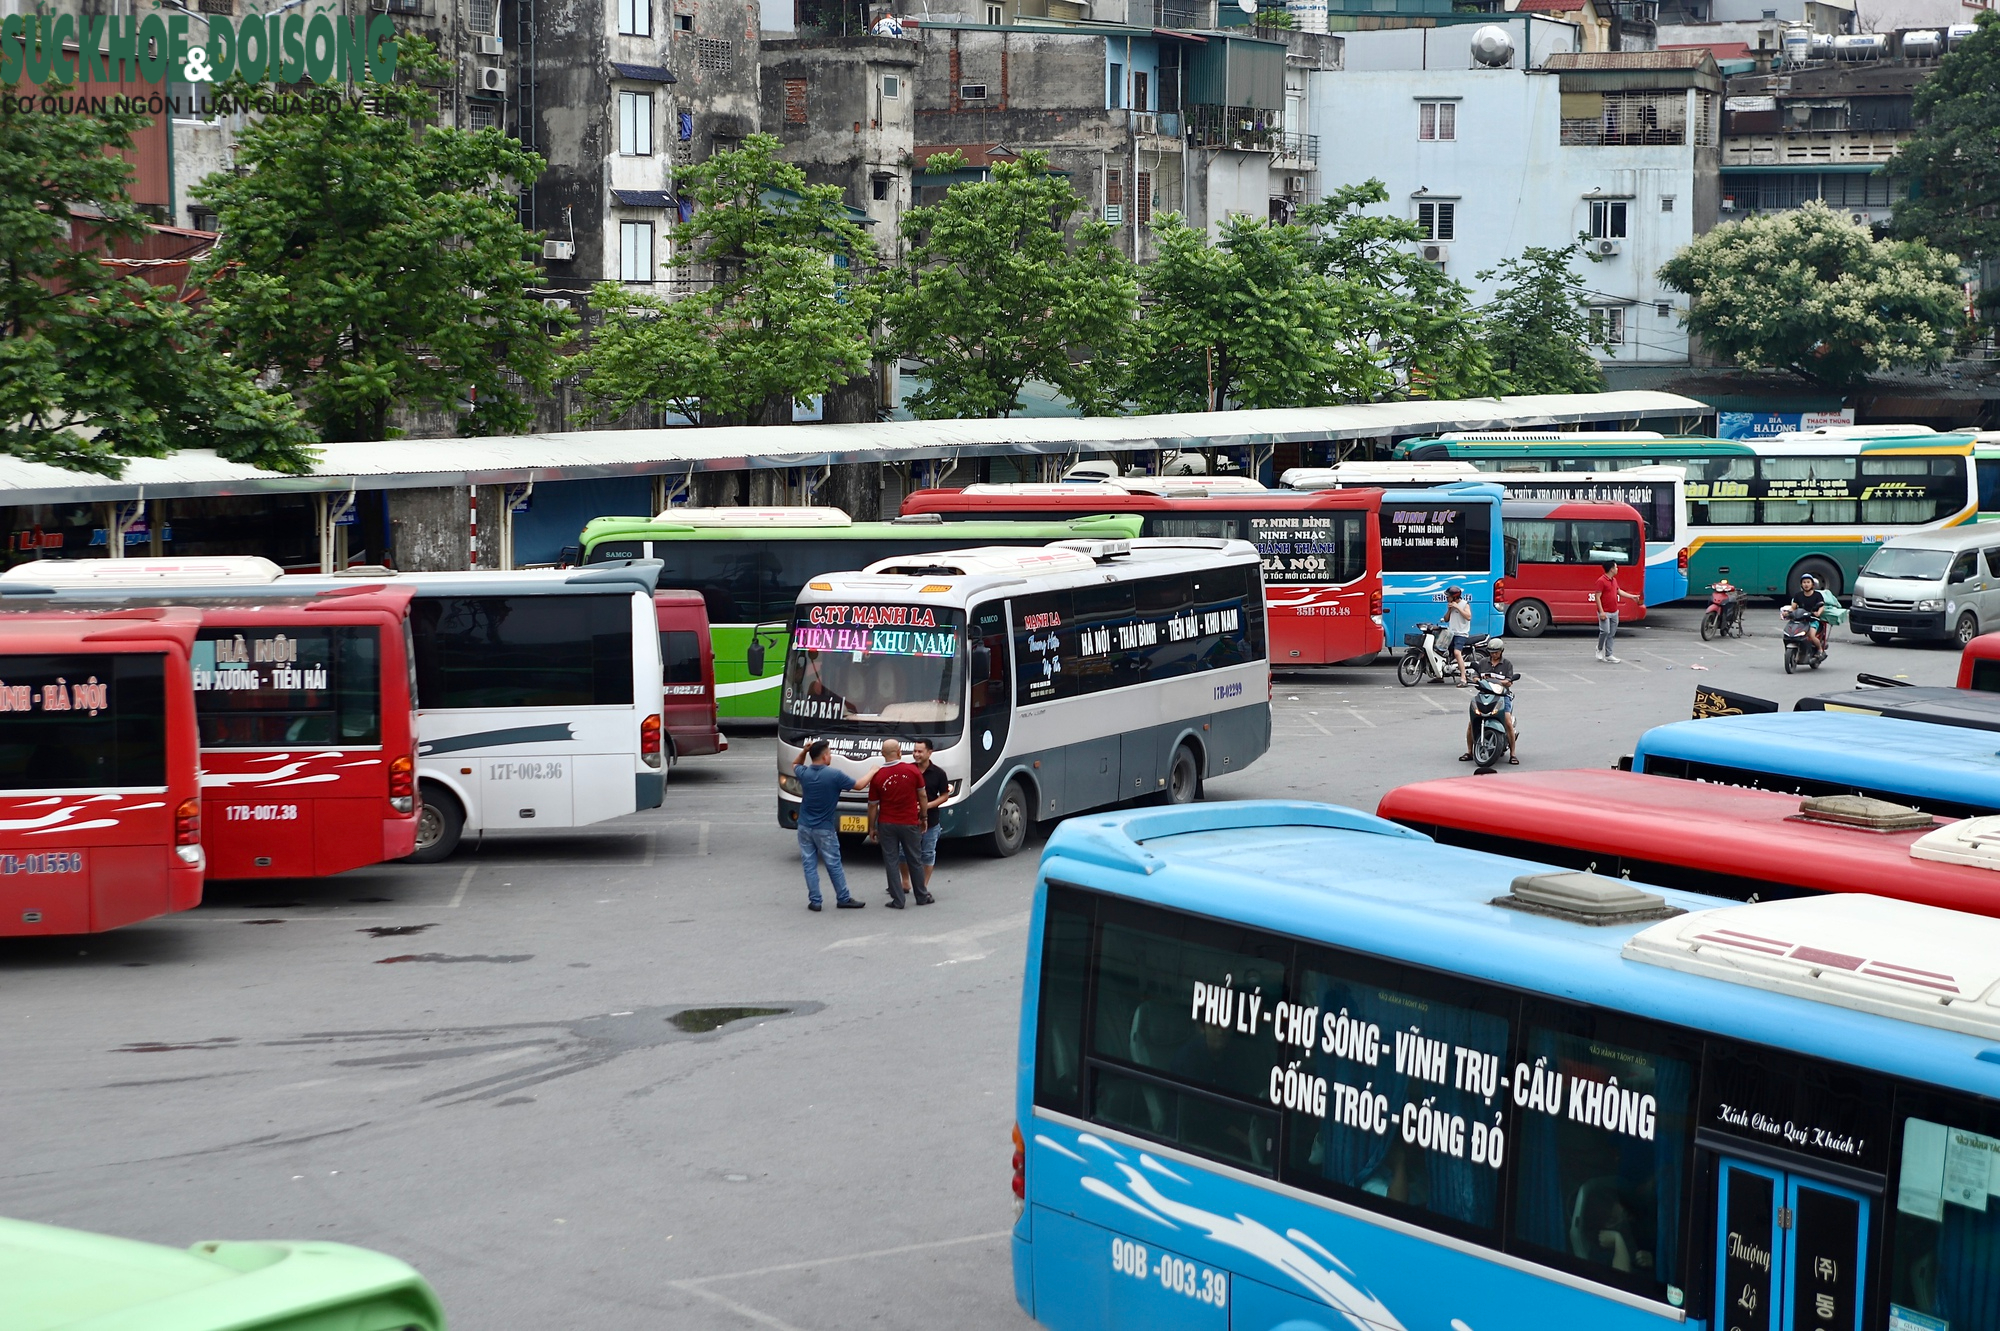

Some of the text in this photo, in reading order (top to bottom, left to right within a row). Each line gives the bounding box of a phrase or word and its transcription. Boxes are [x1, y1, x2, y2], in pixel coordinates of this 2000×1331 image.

[1302, 515, 1331, 528] BÌNH
[1398, 523, 1444, 534] TP NINH BÌNH
[1259, 531, 1288, 540] NINH
[1289, 555, 1326, 572] NỘI
[810, 606, 936, 629] C.TY MẠNH LA
[980, 615, 998, 624] SAMCO
[1024, 611, 1062, 632] MẠNH LA
[913, 632, 955, 655] NAM
[1081, 627, 1094, 656] HÀ
[1094, 624, 1111, 657] NỘI
[1118, 621, 1138, 650] THÁI
[1138, 620, 1157, 647] BÌNH
[1185, 608, 1199, 640] HẢI
[1204, 613, 1221, 635] KHU
[1220, 609, 1239, 632] NAM
[216, 633, 298, 669] HÀ NỘI
[214, 668, 259, 691] XƯƠNG
[304, 662, 327, 690] HẢI
[43, 677, 71, 711] HÀ
[72, 675, 108, 717] NỘI
[663, 685, 705, 695] B-022.71
[490, 762, 563, 780] 17F-002.36
[225, 804, 298, 820] 17B-007.38
[0, 852, 82, 875] 7B-01556
[1191, 973, 1233, 1028] PHỦ
[1236, 987, 1262, 1035] LÝ
[1274, 1001, 1319, 1057] CHỢ
[1322, 1007, 1380, 1066] SÔNG
[1395, 1025, 1448, 1085] VĨNH
[1455, 1045, 1498, 1105] TRỤ
[1513, 1056, 1563, 1115] CẦU
[1568, 1076, 1657, 1141] KHÔNG
[1269, 1061, 1327, 1118] CỐNG
[1333, 1082, 1388, 1134] TRÓC
[1401, 1096, 1464, 1158] CỐNG
[1471, 1111, 1504, 1169] ĐỎ
[1717, 1103, 1749, 1127] Kính
[1751, 1112, 1781, 1135] Chào
[1784, 1120, 1808, 1145] Quý
[1810, 1127, 1854, 1154] Khách
[1112, 1237, 1148, 1279] 90B
[1728, 1231, 1770, 1317] Thượng Lộ
